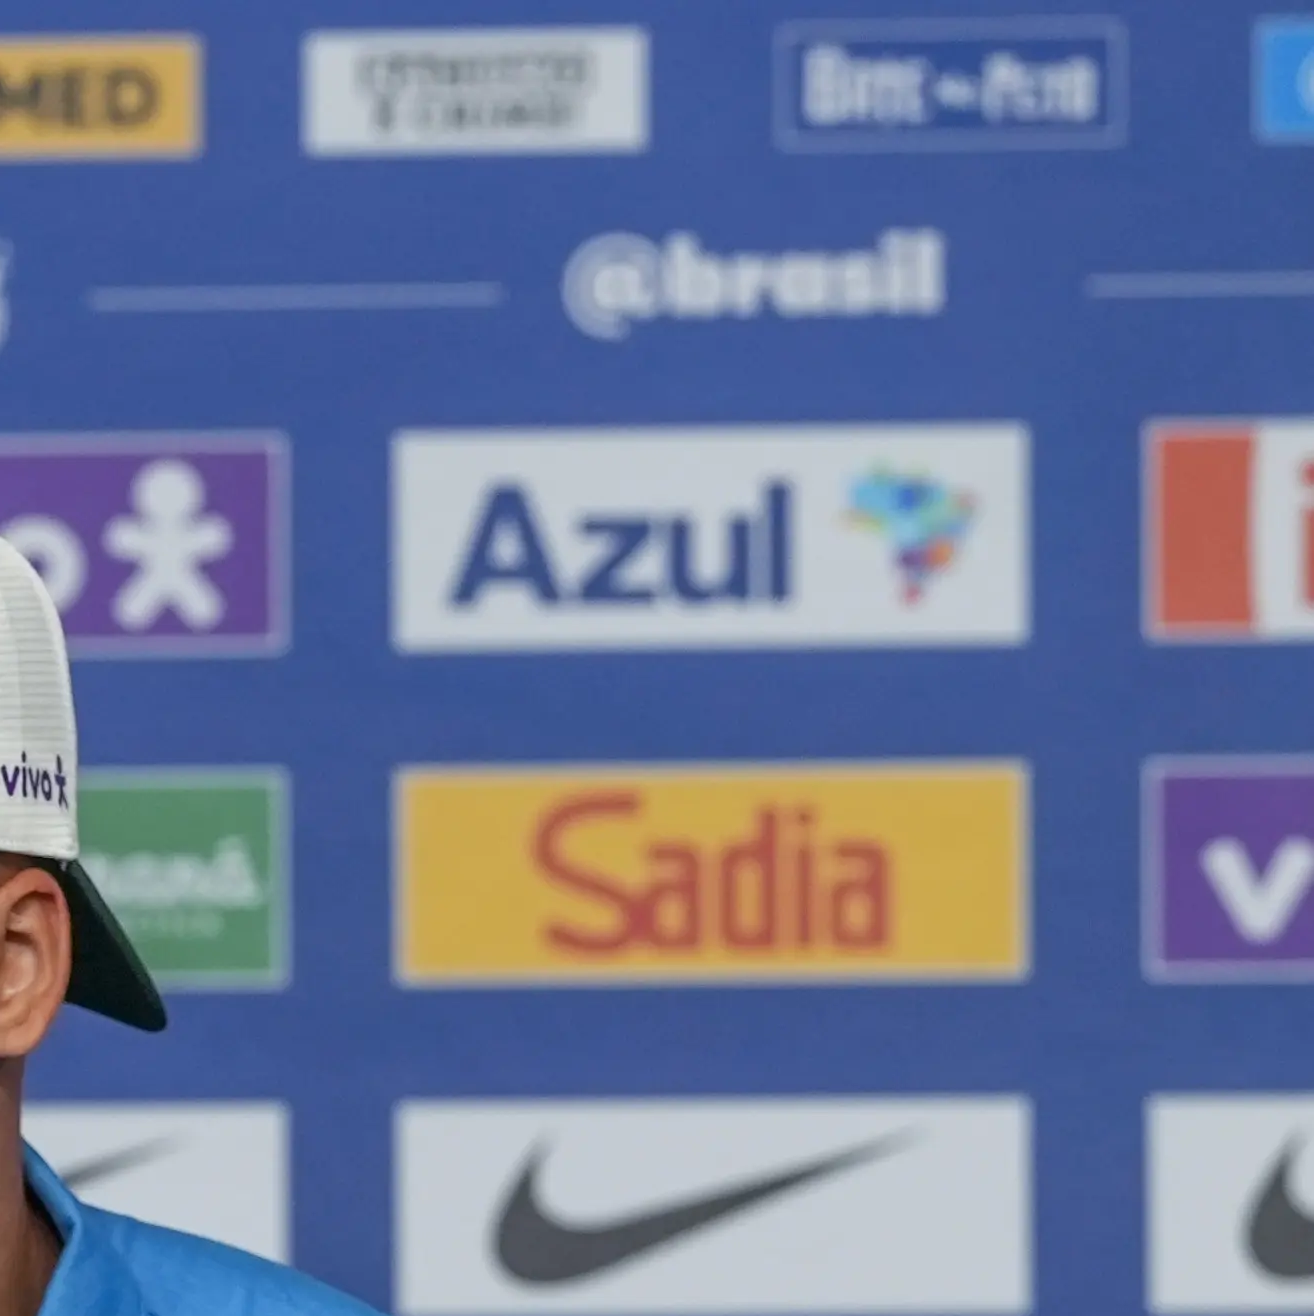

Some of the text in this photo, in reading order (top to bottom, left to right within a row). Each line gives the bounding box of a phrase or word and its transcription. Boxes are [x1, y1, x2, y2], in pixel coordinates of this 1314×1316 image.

[565, 230, 943, 337] @brasil
[450, 480, 792, 608] Azul
[0, 751, 52, 801] vivo
[531, 792, 891, 957] Sadia
